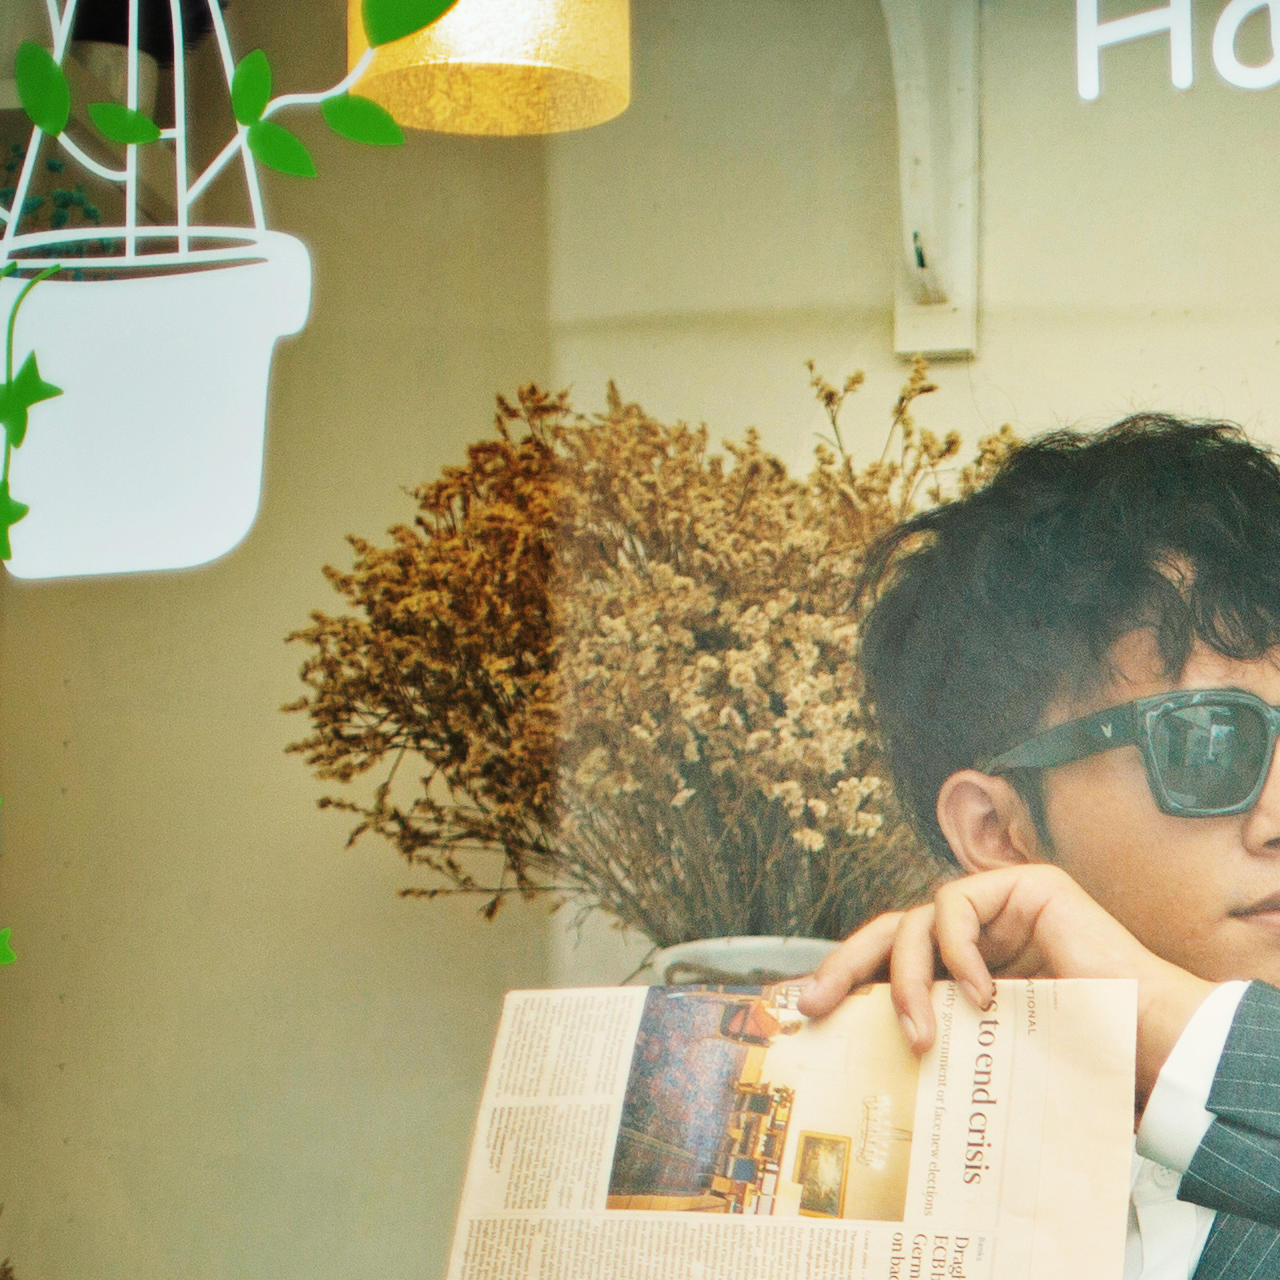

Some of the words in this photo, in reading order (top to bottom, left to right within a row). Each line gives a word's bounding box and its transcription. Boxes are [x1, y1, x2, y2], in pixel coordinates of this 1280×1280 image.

[936, 1011, 953, 1087] government
[977, 1020, 1000, 1047] to
[971, 1053, 998, 1105] end
[936, 1090, 945, 1101] or
[933, 1106, 947, 1131] face
[931, 1133, 941, 1159] new
[962, 1111, 993, 1185] crisis
[924, 1161, 941, 1216] elections
[891, 1231, 904, 1252] on
[931, 1234, 949, 1269] ECB
